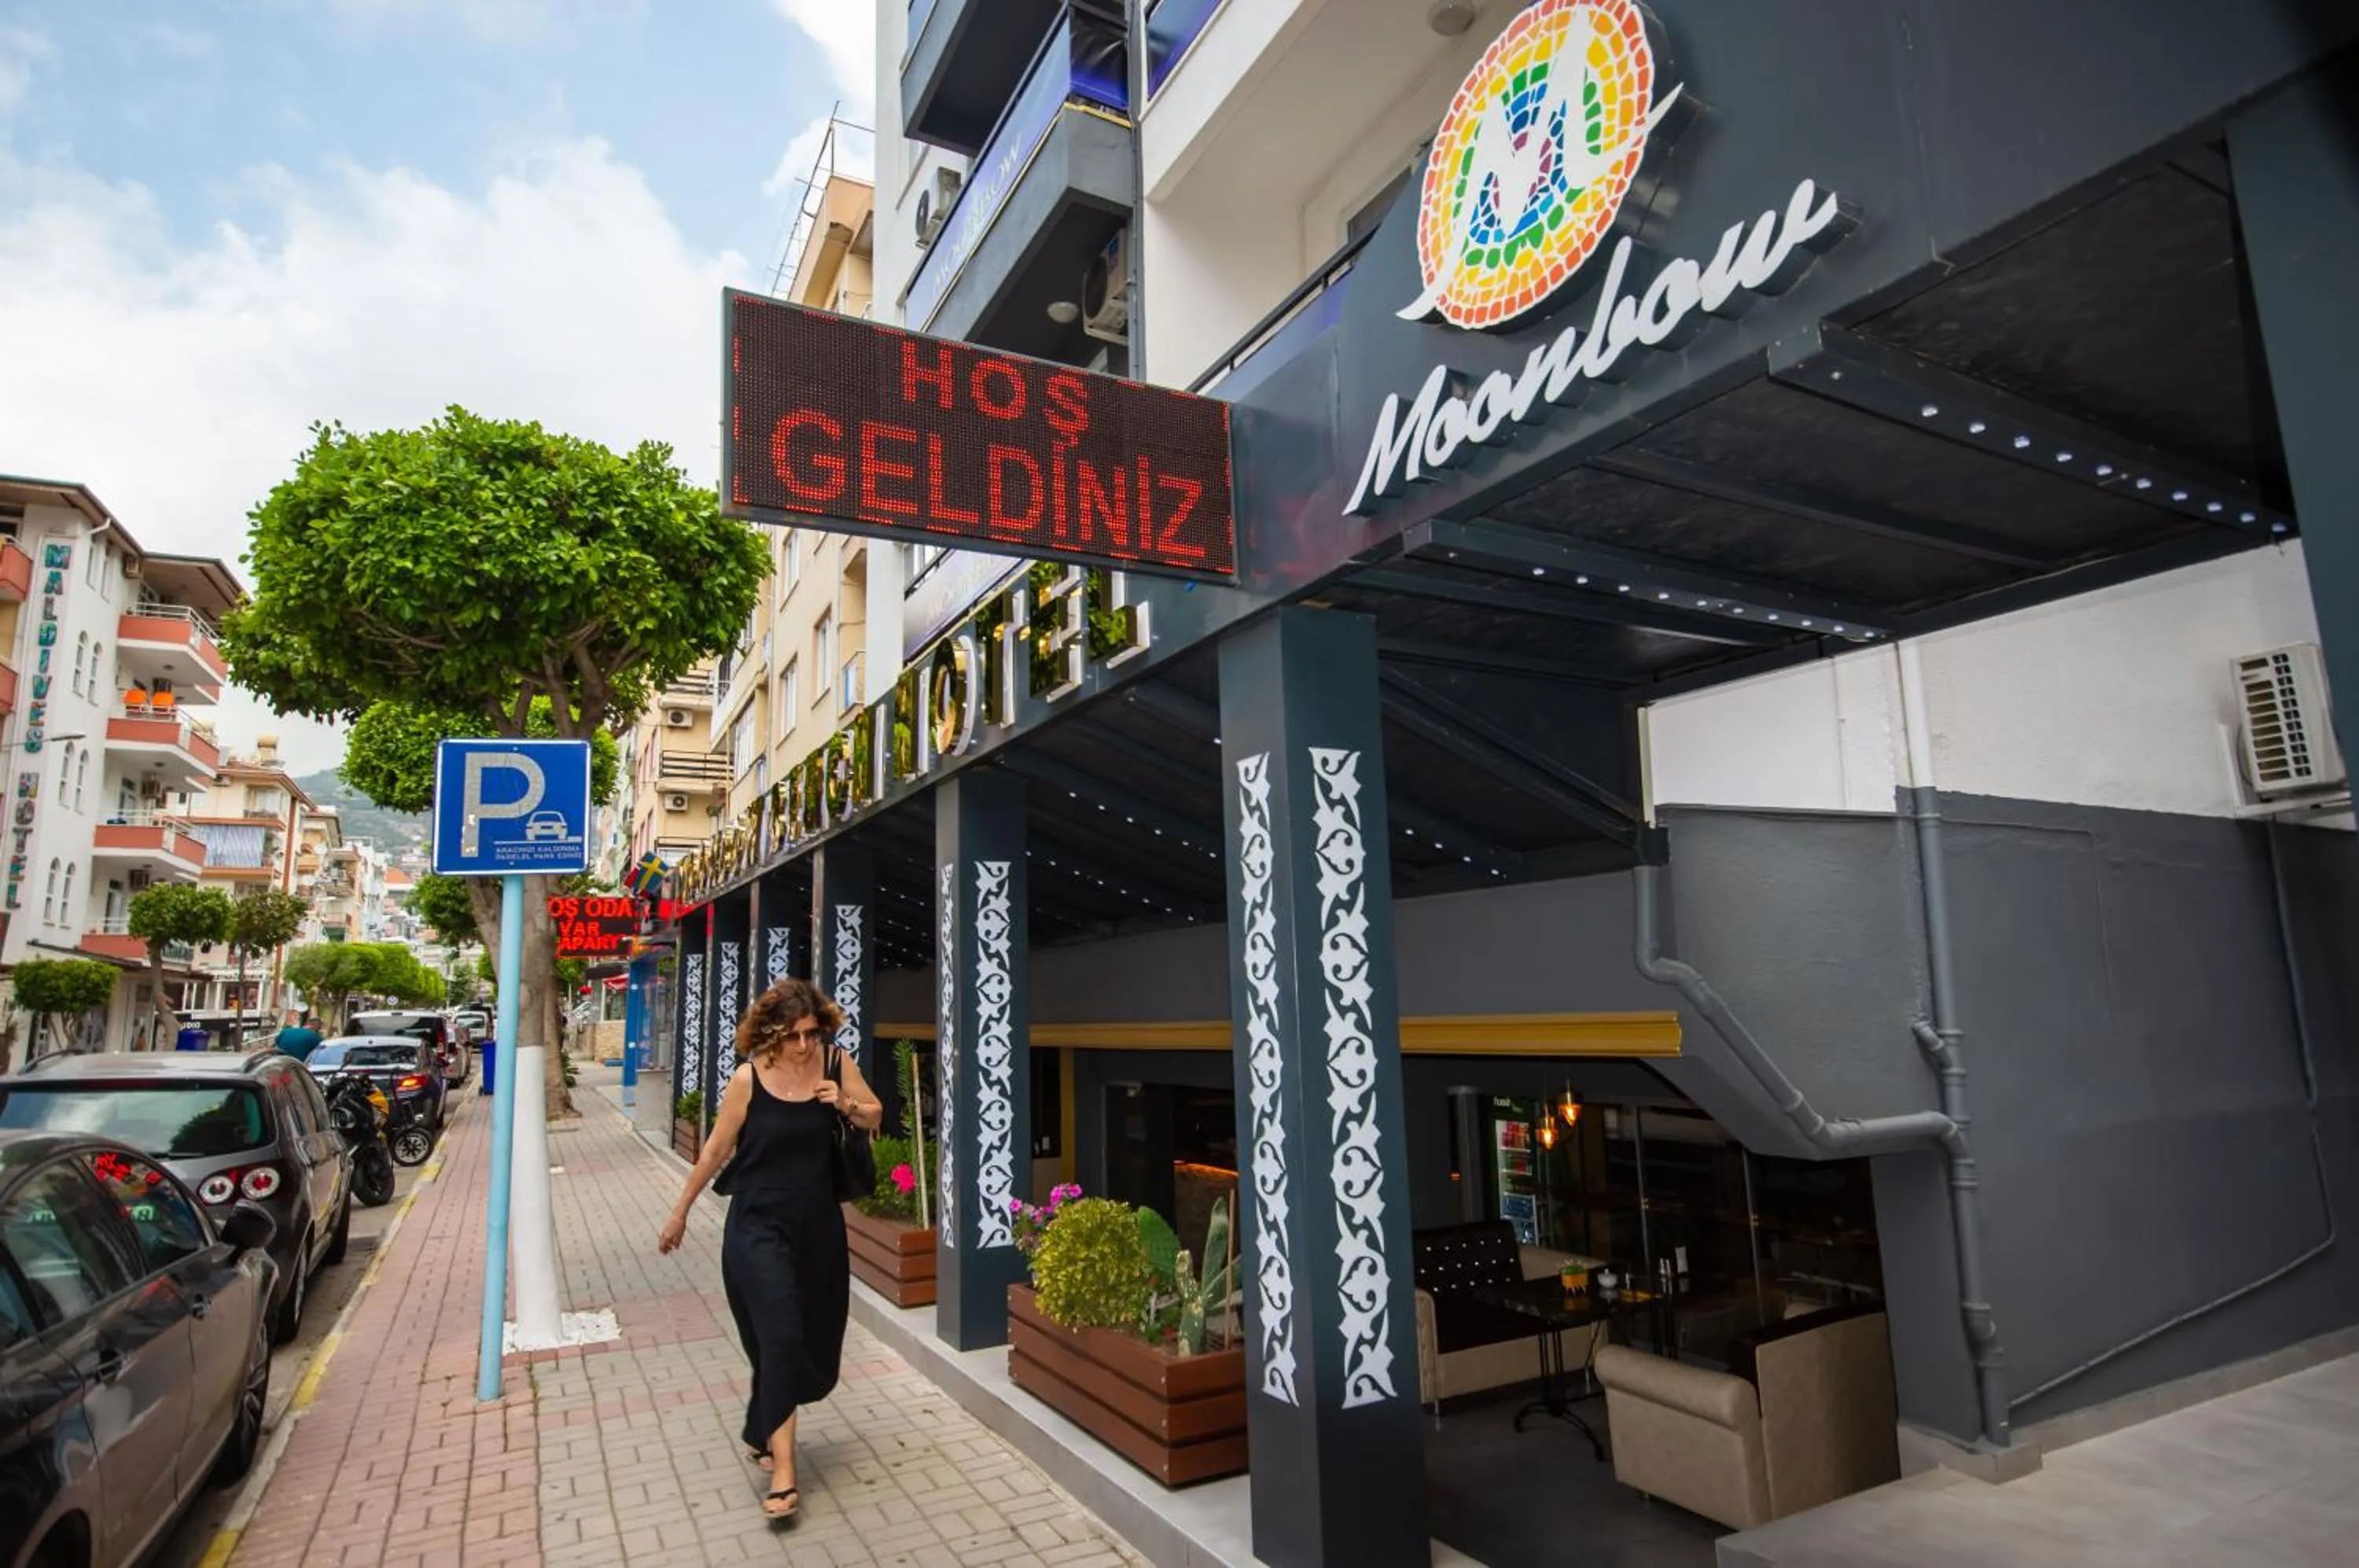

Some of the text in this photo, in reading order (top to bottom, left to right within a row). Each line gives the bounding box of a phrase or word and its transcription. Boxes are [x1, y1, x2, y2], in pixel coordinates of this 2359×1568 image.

[900, 340, 1090, 447] HOŞ
[1341, 179, 1838, 516] Moonbow
[771, 408, 1206, 558] GELDİNİZ
[24, 543, 71, 753] MALDIVES
[6, 772, 39, 909] HOTEL
[461, 752, 546, 857] P
[559, 921, 600, 936] VAR
[585, 898, 634, 918] ODA
